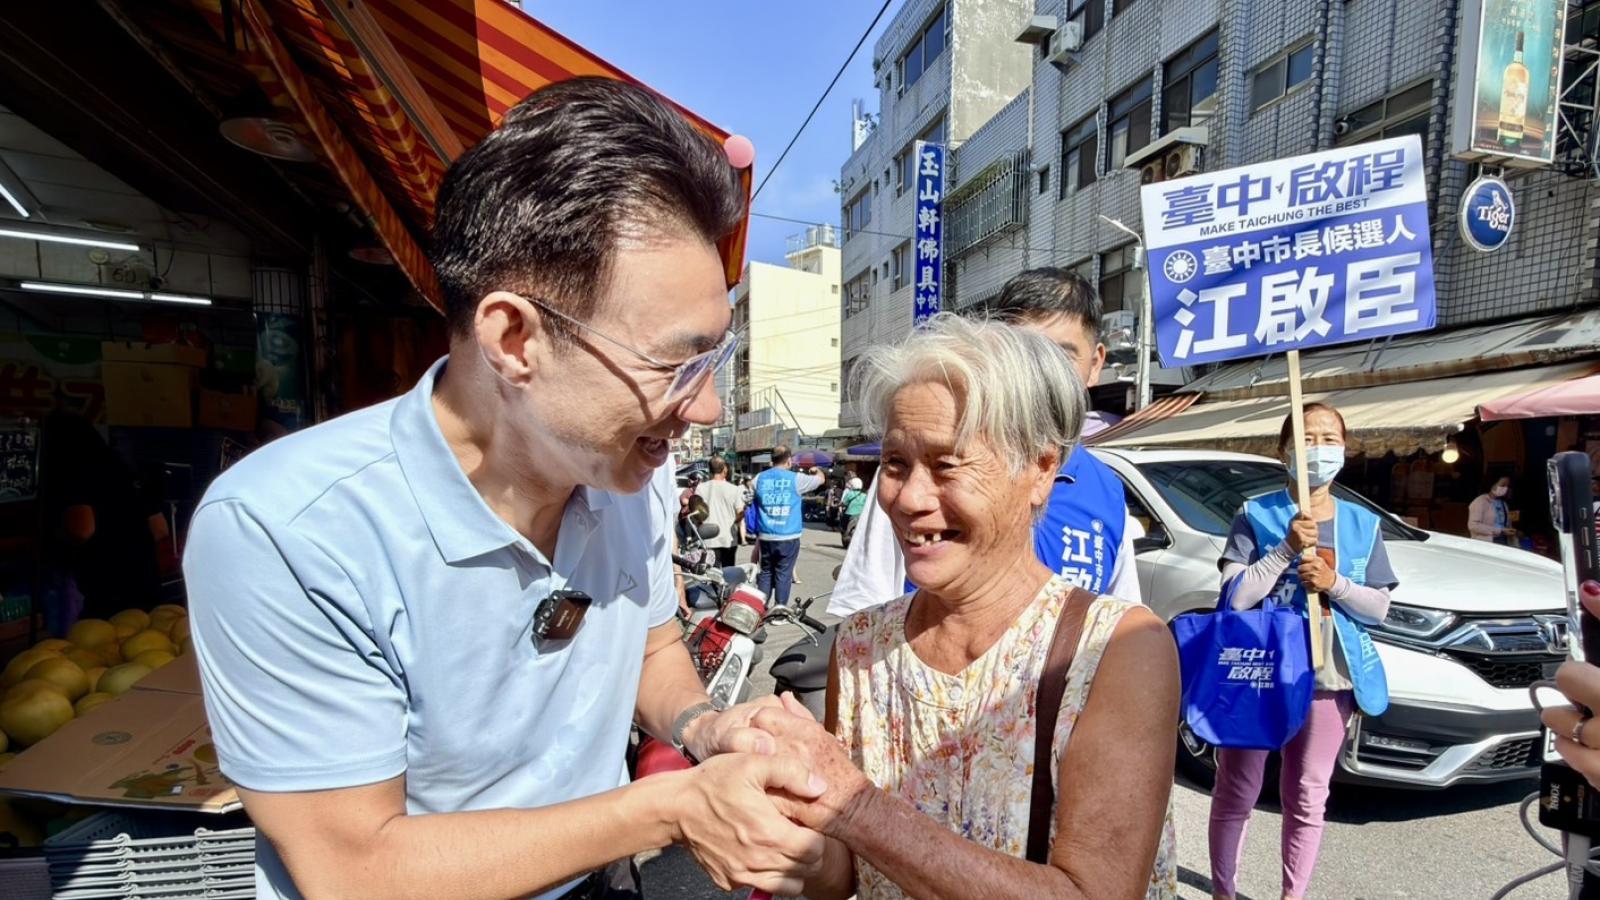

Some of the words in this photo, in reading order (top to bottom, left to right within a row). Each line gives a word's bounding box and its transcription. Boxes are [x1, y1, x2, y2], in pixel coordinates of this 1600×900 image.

[917, 152, 939, 293] 玉山軒佛具
[1162, 174, 1271, 230] 臺中
[1200, 222, 1235, 236] MAKE
[1238, 209, 1304, 229] TAICHUNG
[1306, 205, 1333, 217] THE
[1335, 198, 1370, 212] BEST
[1477, 205, 1509, 229] Tiger
[1202, 214, 1416, 276] 臺中市長候選人
[1173, 252, 1421, 359] 江啟臣
[1219, 648, 1266, 662] 臺中
